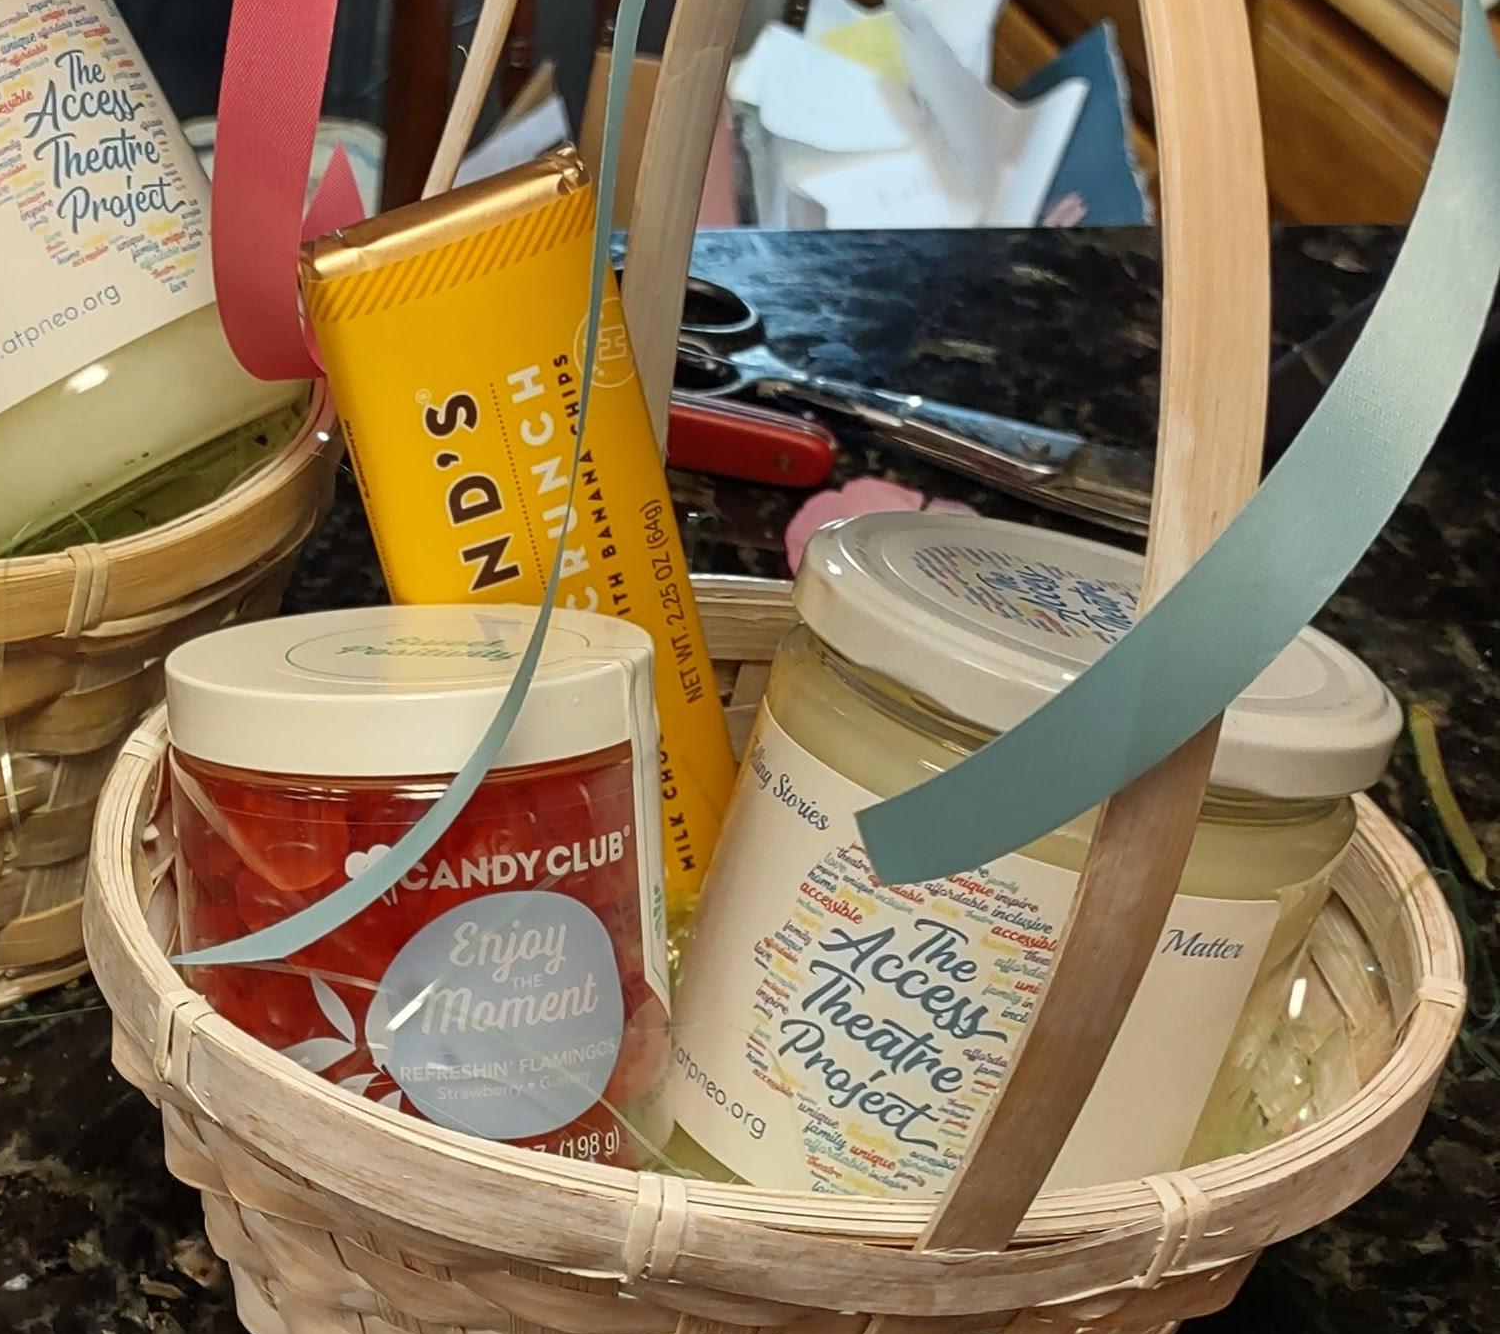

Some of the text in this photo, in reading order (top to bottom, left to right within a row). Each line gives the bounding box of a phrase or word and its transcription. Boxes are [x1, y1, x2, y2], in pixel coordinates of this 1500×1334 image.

[54, 49, 107, 93] The
[23, 79, 146, 140] Access
[33, 128, 162, 190] Theatre
[56, 173, 187, 236] Project
[580, 450, 617, 560] BANANA
[639, 499, 670, 550] (64g)
[651, 551, 674, 582] OZ
[678, 670, 705, 705] NET
[773, 773, 831, 831] Stories
[400, 830, 625, 892] CANDY CLUB
[669, 812, 696, 872] MILK
[799, 881, 863, 925] accessible
[807, 870, 838, 894] home
[923, 882, 1039, 914] affordable inspire
[948, 874, 995, 898] unique
[990, 905, 1053, 935] inclusive
[991, 925, 1058, 953] accessibl
[449, 919, 567, 984] Enjoy
[754, 939, 774, 963] love
[913, 918, 979, 985] The
[1160, 928, 1245, 960] Matter
[421, 973, 600, 1035] Moment
[511, 974, 544, 991] THE
[755, 987, 790, 1016] inspire
[818, 927, 1008, 1043] Access
[1014, 979, 1043, 995] uni
[808, 959, 963, 1095] Theatre
[400, 1037, 617, 1083] REFRESHIN' FLAMINGOS
[437, 1083, 525, 1101] Strawberry
[780, 1018, 939, 1149] Project
[797, 1102, 840, 1130] unique
[802, 1120, 847, 1152] family
[849, 1145, 897, 1171] unique
